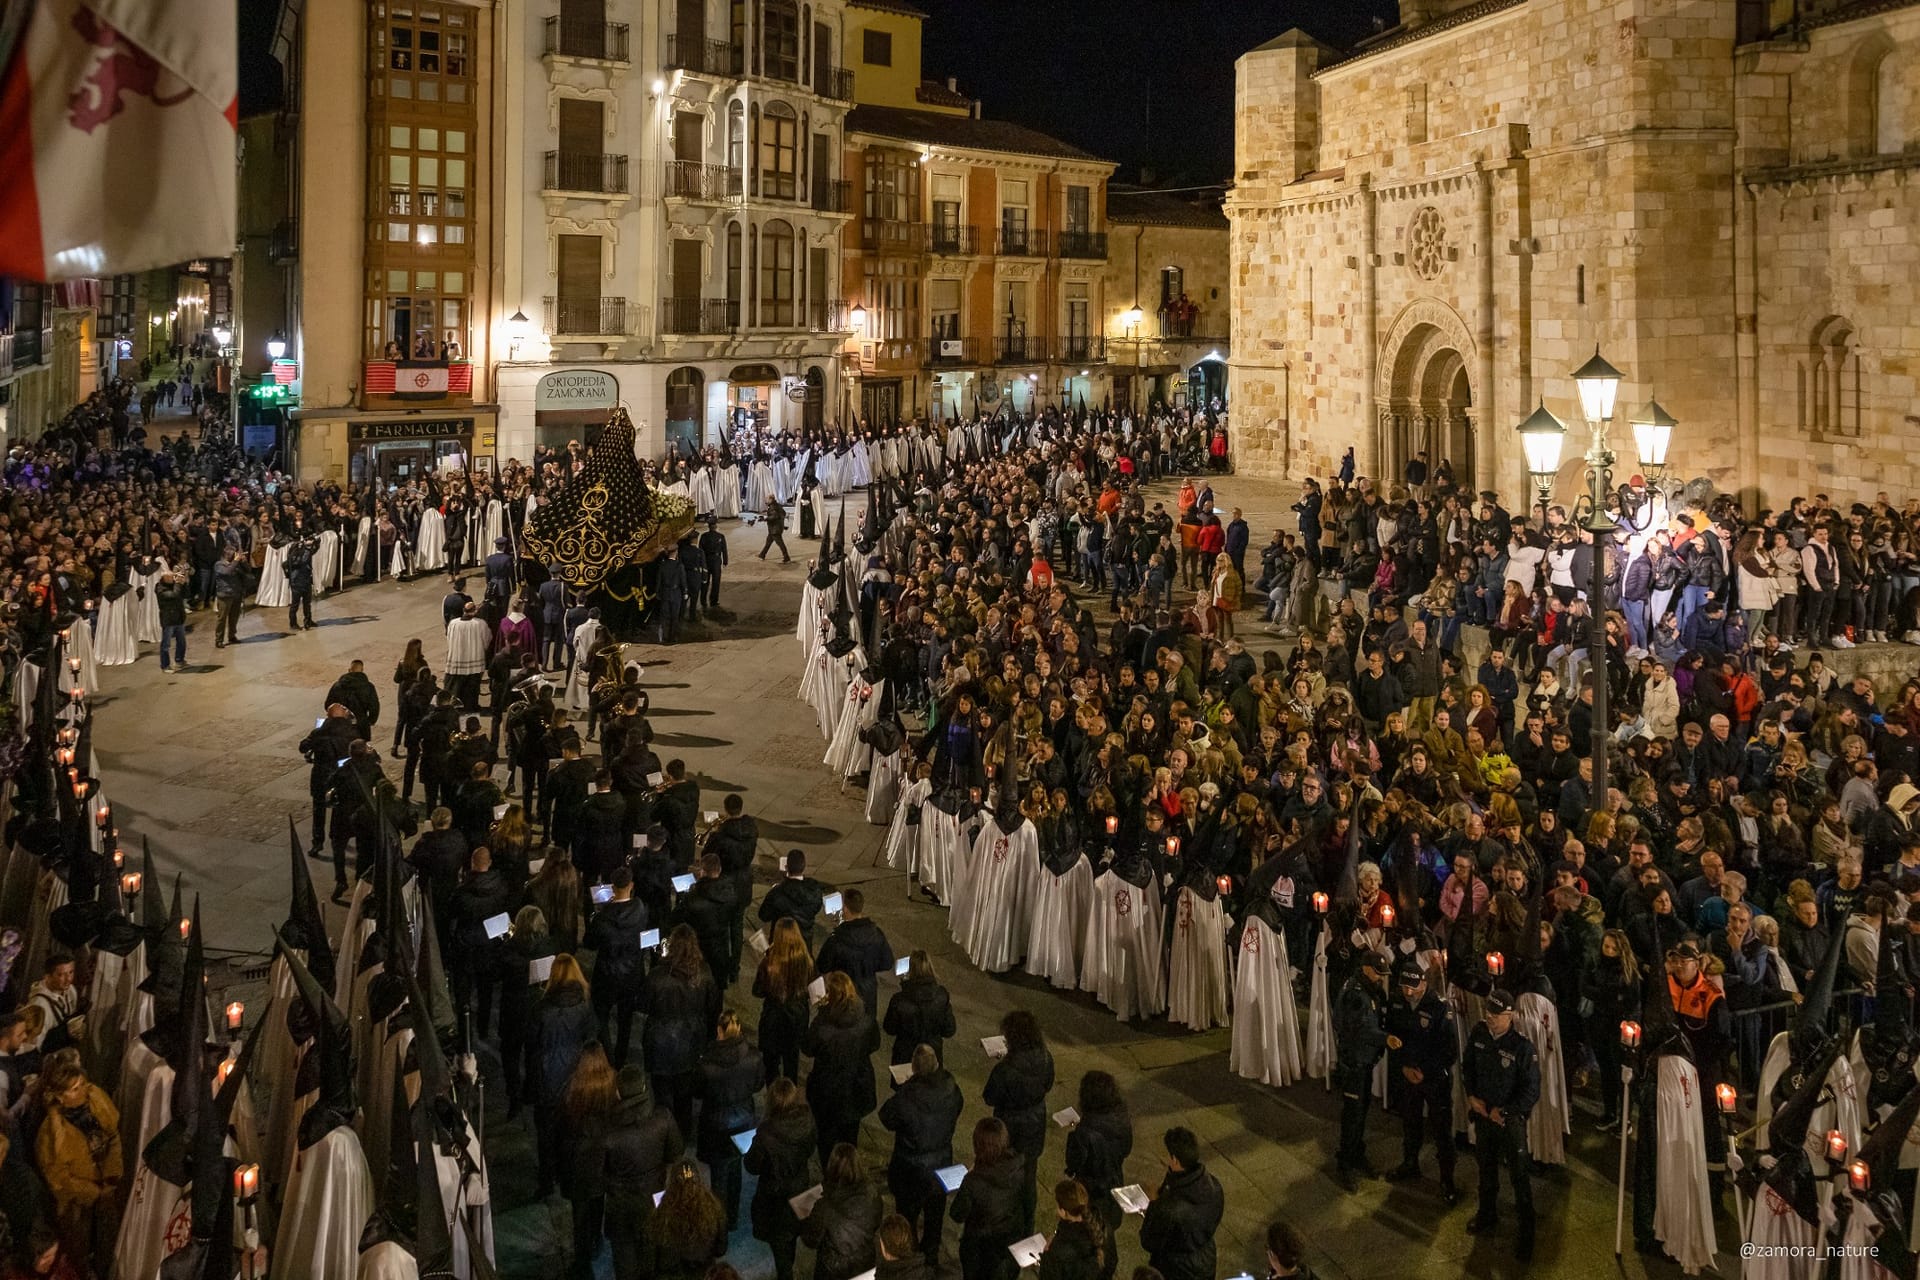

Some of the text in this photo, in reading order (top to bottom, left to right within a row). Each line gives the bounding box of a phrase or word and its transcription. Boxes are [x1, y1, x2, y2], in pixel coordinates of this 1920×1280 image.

[546, 376, 606, 388] ORTOPEDIA
[546, 388, 606, 399] ZAMORANA
[375, 423, 449, 437] FARMACIA
